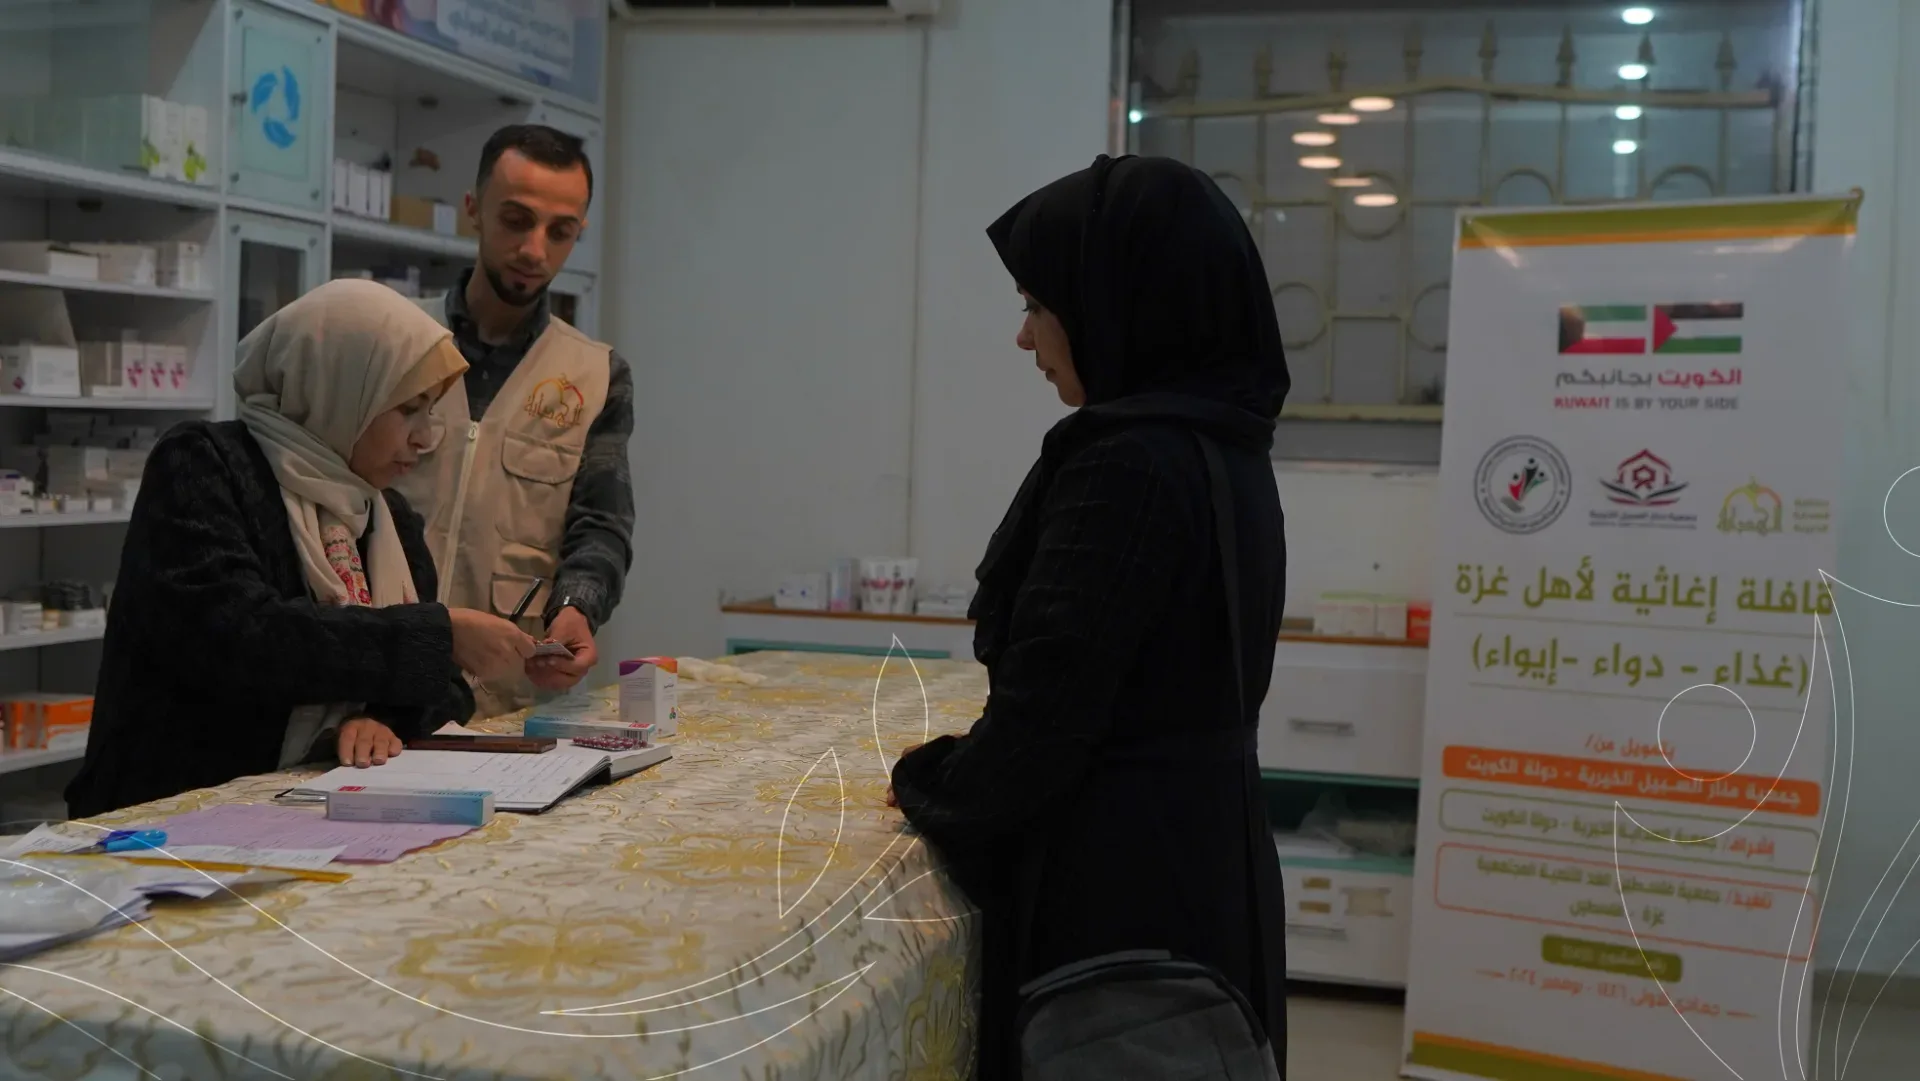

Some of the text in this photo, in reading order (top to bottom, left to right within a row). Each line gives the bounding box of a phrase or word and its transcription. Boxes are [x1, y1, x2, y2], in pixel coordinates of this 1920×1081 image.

[1555, 368, 1742, 389] الكويت بجانبكم
[1554, 396, 1739, 410] KUWAIT IS BY YOUR SIDE
[1456, 556, 1834, 624] قافلة إغاثية لأهل غزة
[1592, 642, 1665, 688] دواء
[1464, 752, 1519, 776] الكويت
